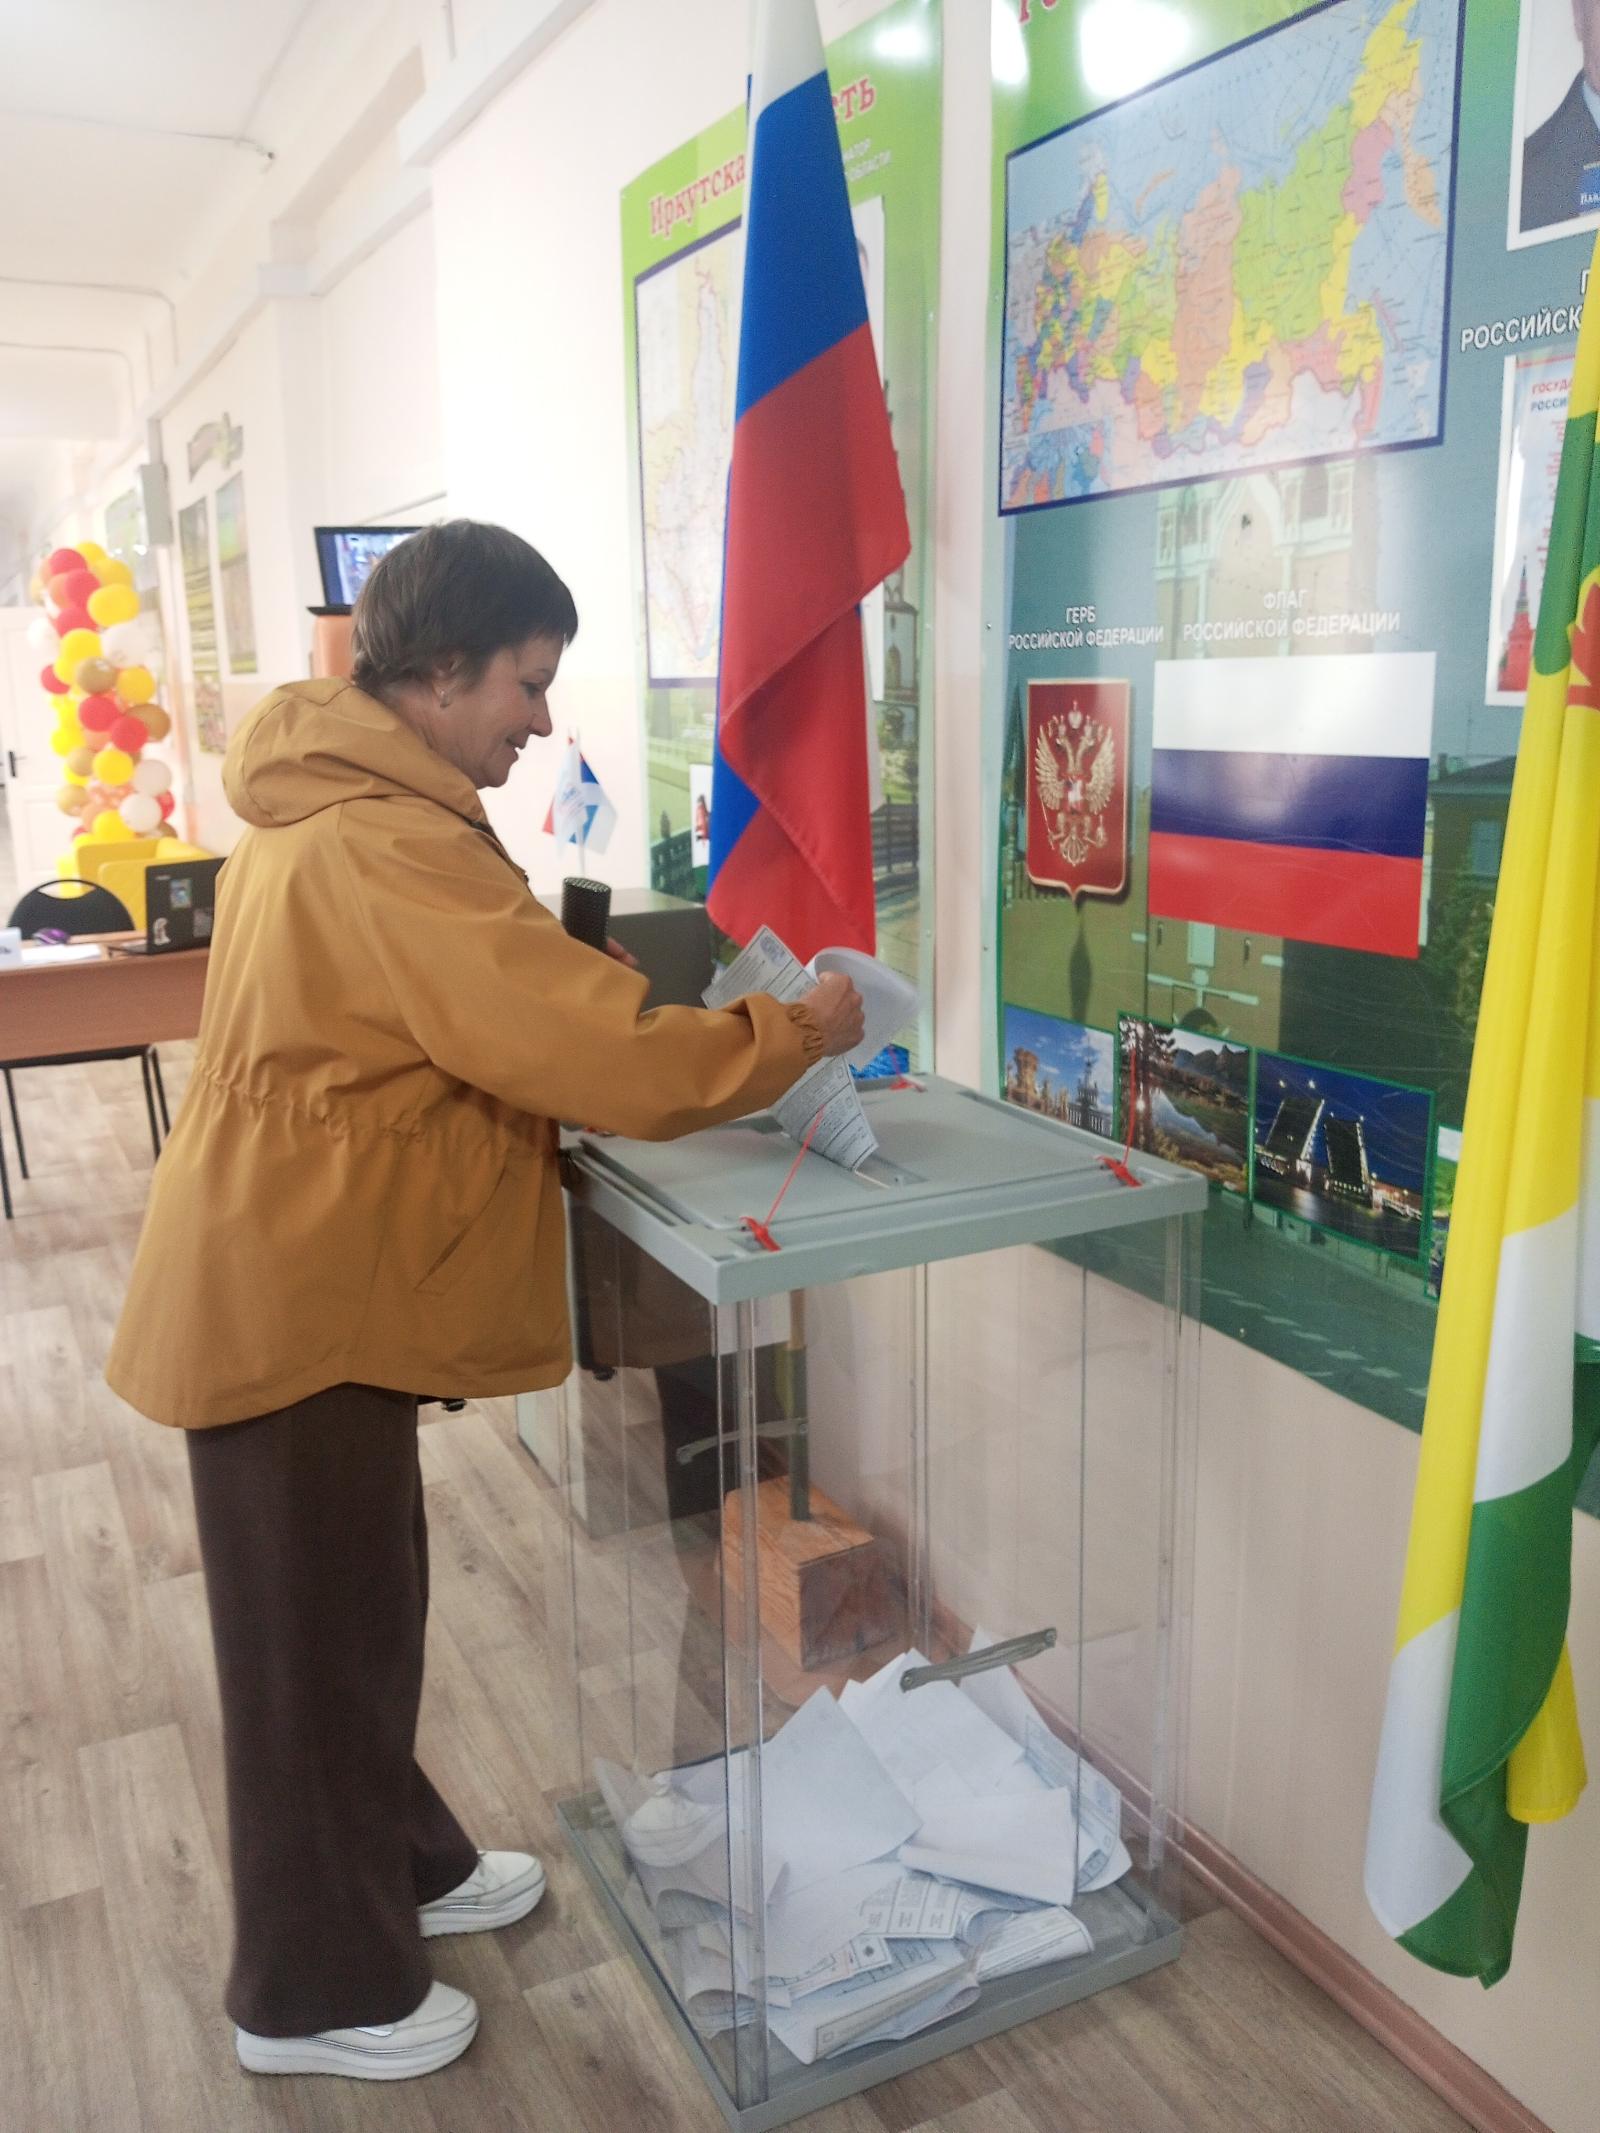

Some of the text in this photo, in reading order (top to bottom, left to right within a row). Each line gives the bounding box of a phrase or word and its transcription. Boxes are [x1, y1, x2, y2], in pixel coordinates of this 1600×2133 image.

[1263, 588, 1308, 609] ФЛАГ
[1066, 605, 1096, 624] ГЕРБ
[1008, 625, 1164, 650] РОССИЙСКОЙ ФЕДЕРАЦИИ
[1184, 611, 1400, 642] РОССИЙСКОЙ ФЕДЕРАЦИИ
